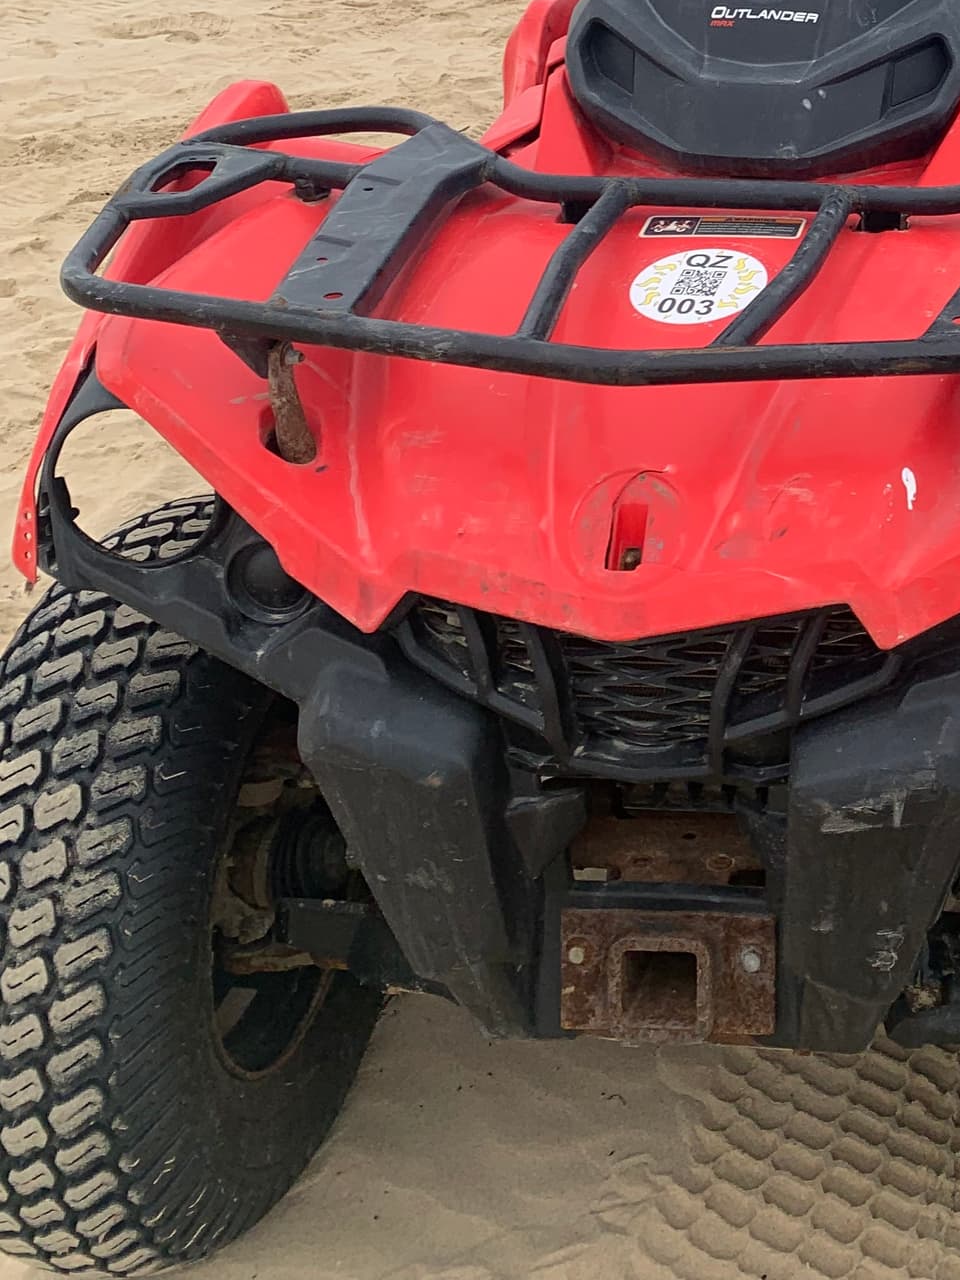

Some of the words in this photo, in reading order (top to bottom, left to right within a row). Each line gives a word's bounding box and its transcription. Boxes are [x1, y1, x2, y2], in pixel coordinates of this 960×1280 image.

[711, 6, 819, 23] OUTLANDER
[686, 253, 734, 269] QZ
[657, 297, 714, 315] 003
